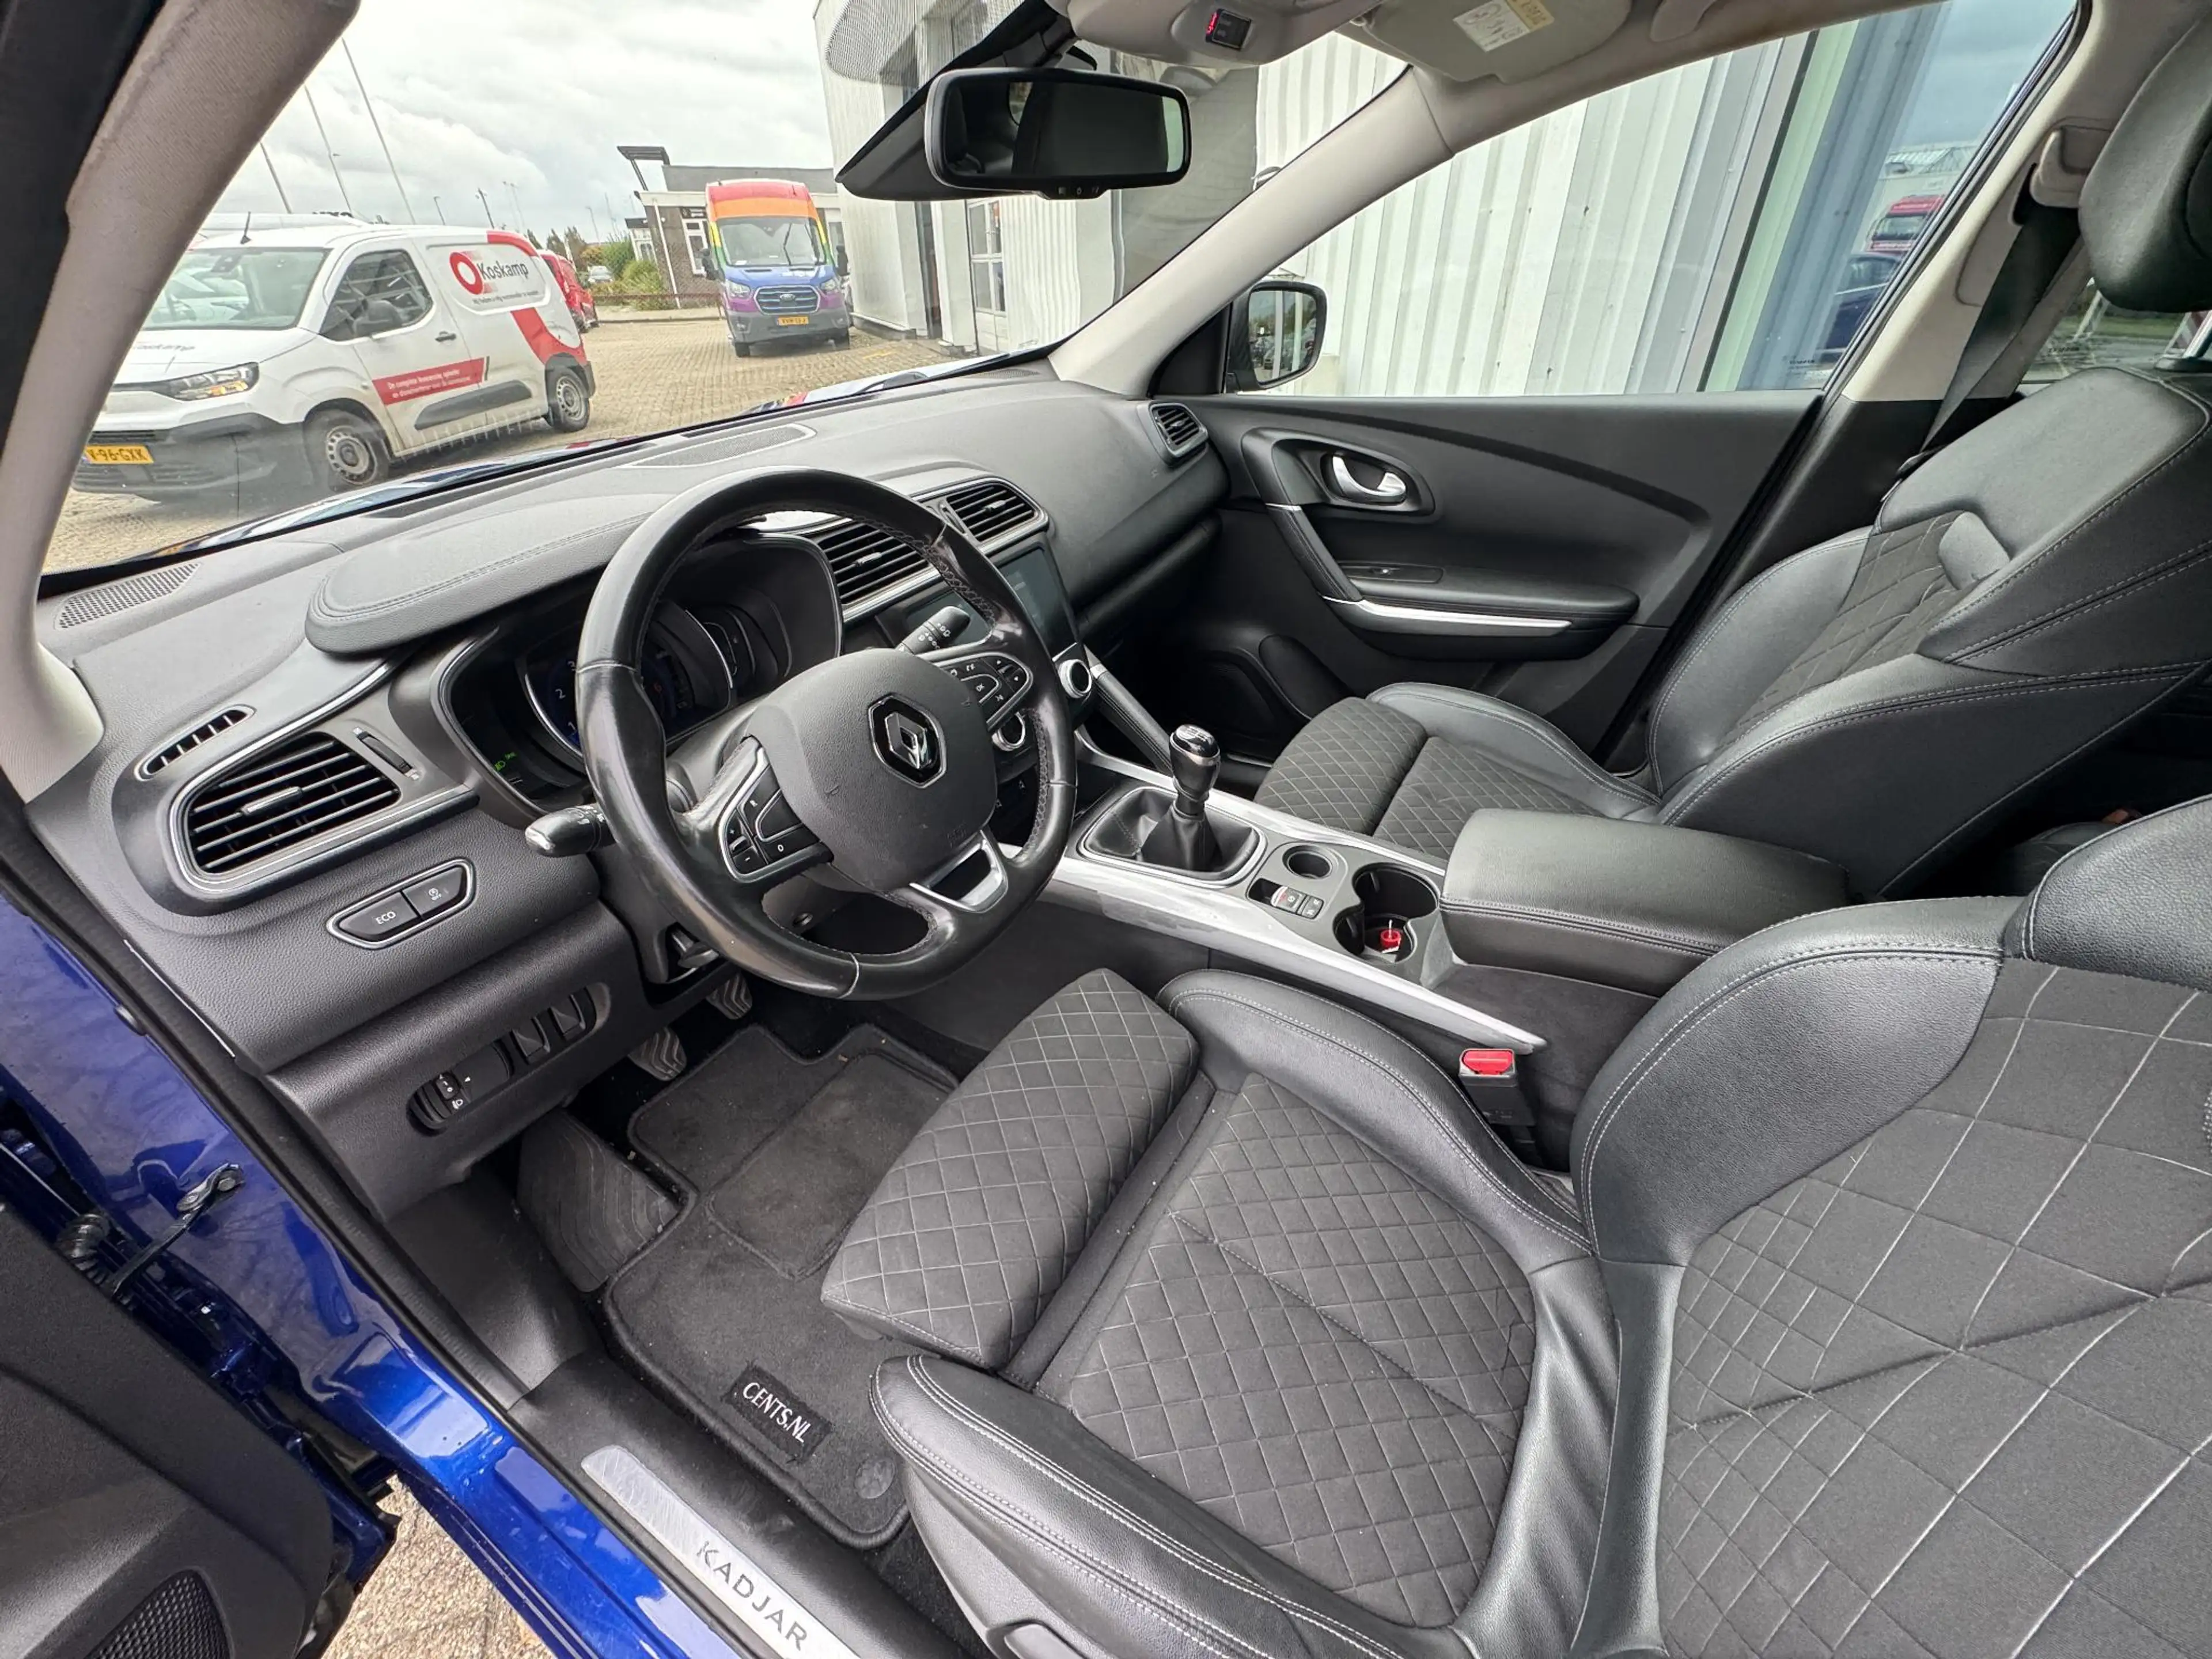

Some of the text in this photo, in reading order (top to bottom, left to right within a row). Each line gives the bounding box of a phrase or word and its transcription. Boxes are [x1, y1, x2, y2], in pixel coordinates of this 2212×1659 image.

[476, 260, 529, 280] Koskamp
[555, 688, 566, 699] 2
[375, 911, 396, 925] ECO
[743, 1382, 811, 1443] CENTS.NL
[696, 1540, 808, 1652] KADJAR
